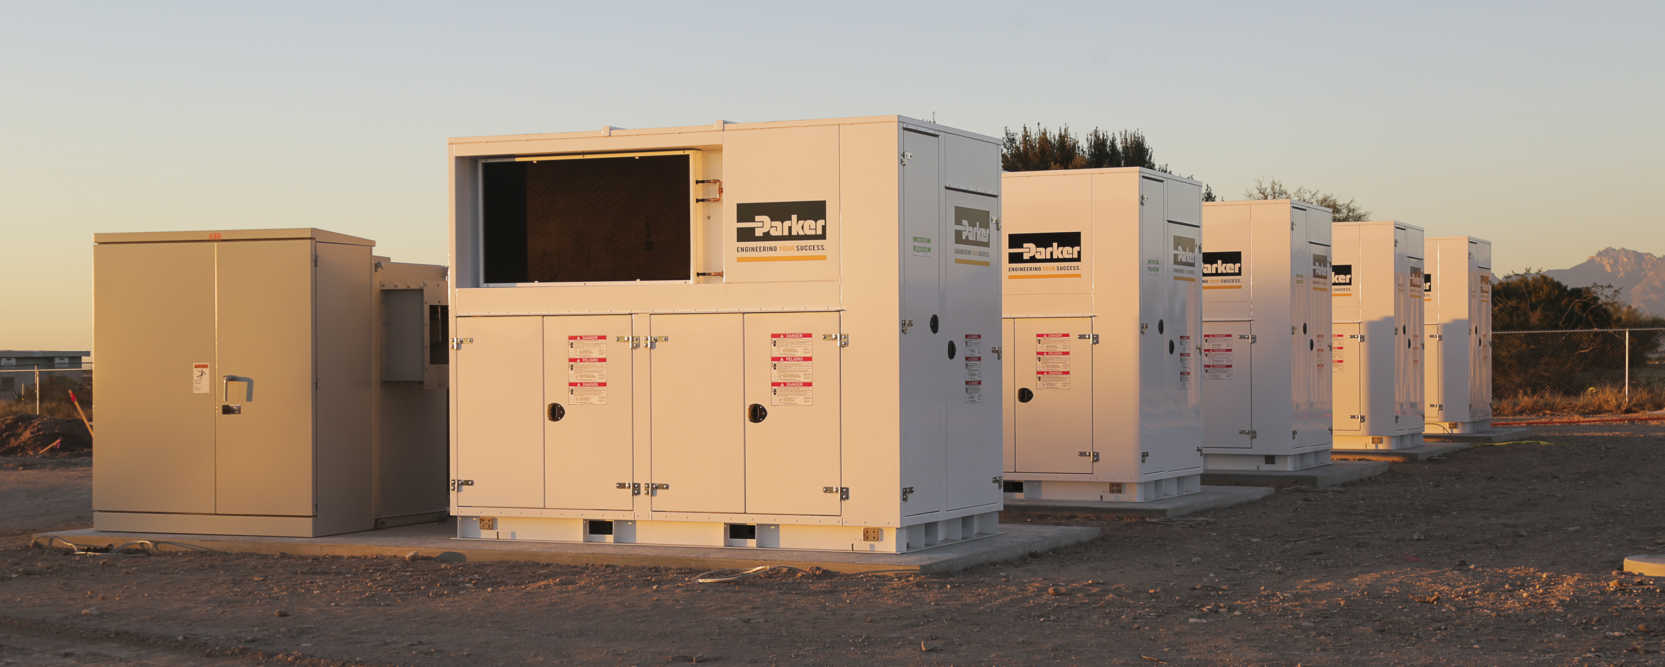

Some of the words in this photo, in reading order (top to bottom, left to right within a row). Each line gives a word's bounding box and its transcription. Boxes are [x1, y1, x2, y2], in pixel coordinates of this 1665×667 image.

[755, 214, 825, 237] Parker
[962, 219, 989, 242] Parker
[1023, 242, 1081, 259] Parker
[1202, 259, 1241, 274] arker
[1332, 271, 1351, 283] ker
